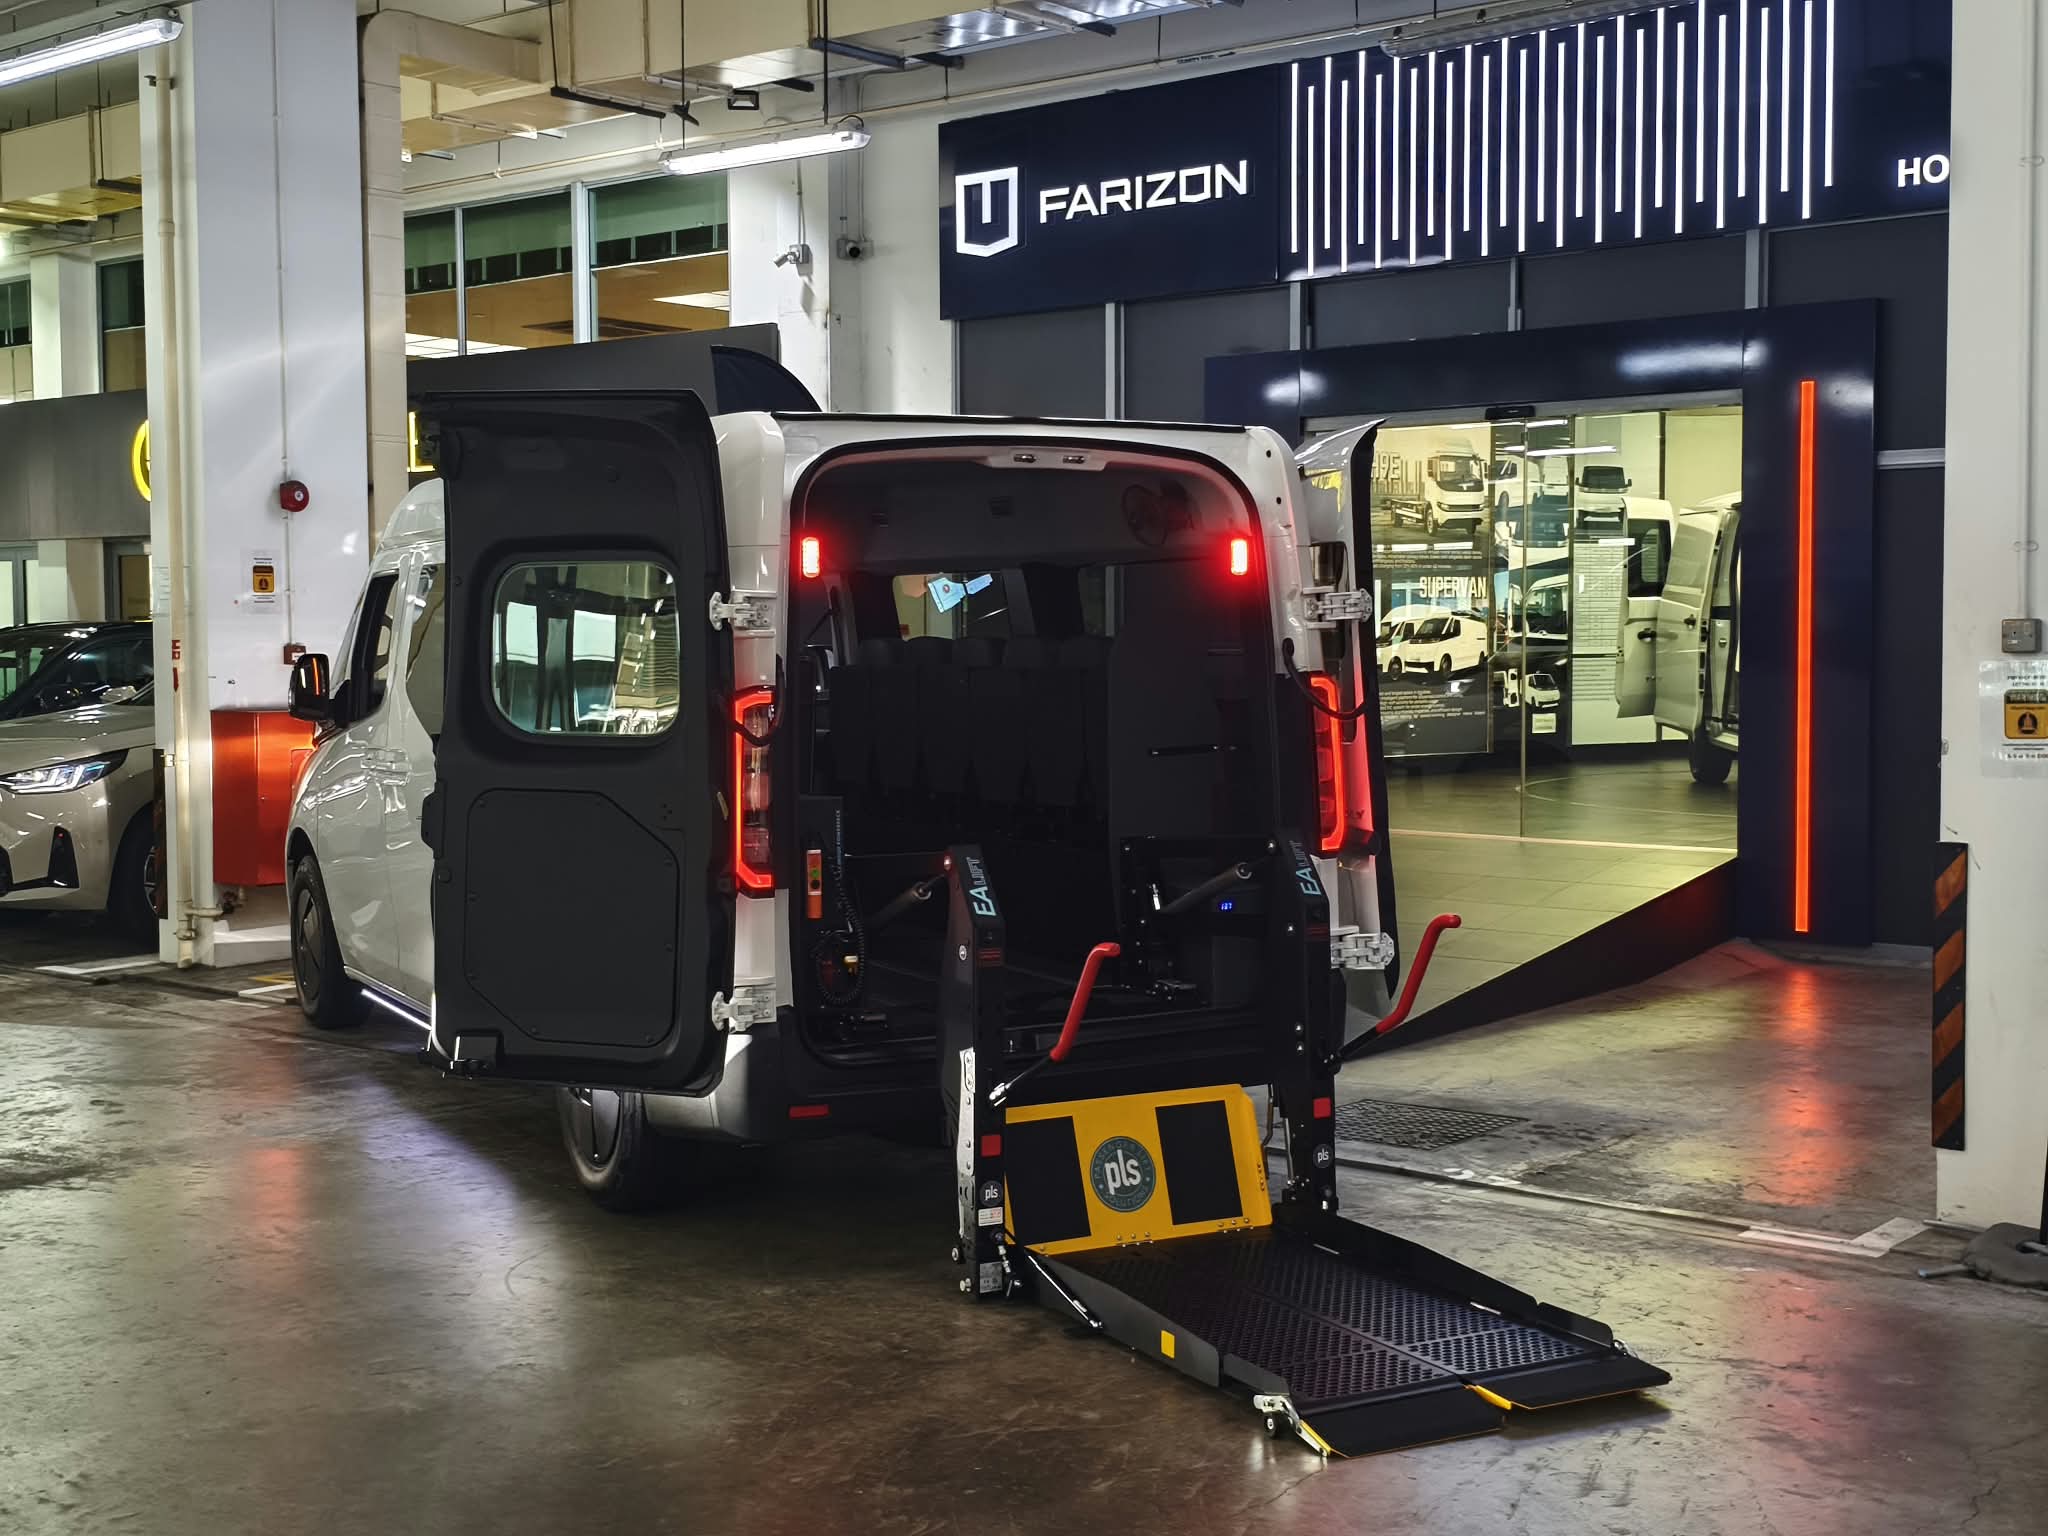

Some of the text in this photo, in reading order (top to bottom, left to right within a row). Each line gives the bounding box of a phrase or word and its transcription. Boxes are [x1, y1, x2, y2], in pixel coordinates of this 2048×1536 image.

[1897, 154, 1950, 188] HO
[1039, 159, 1248, 224] FARIZON
[1419, 576, 1487, 599] SUPERVAN
[1316, 1148, 1329, 1164] pls
[1104, 1149, 1142, 1196] pls
[984, 1185, 999, 1201] pls
